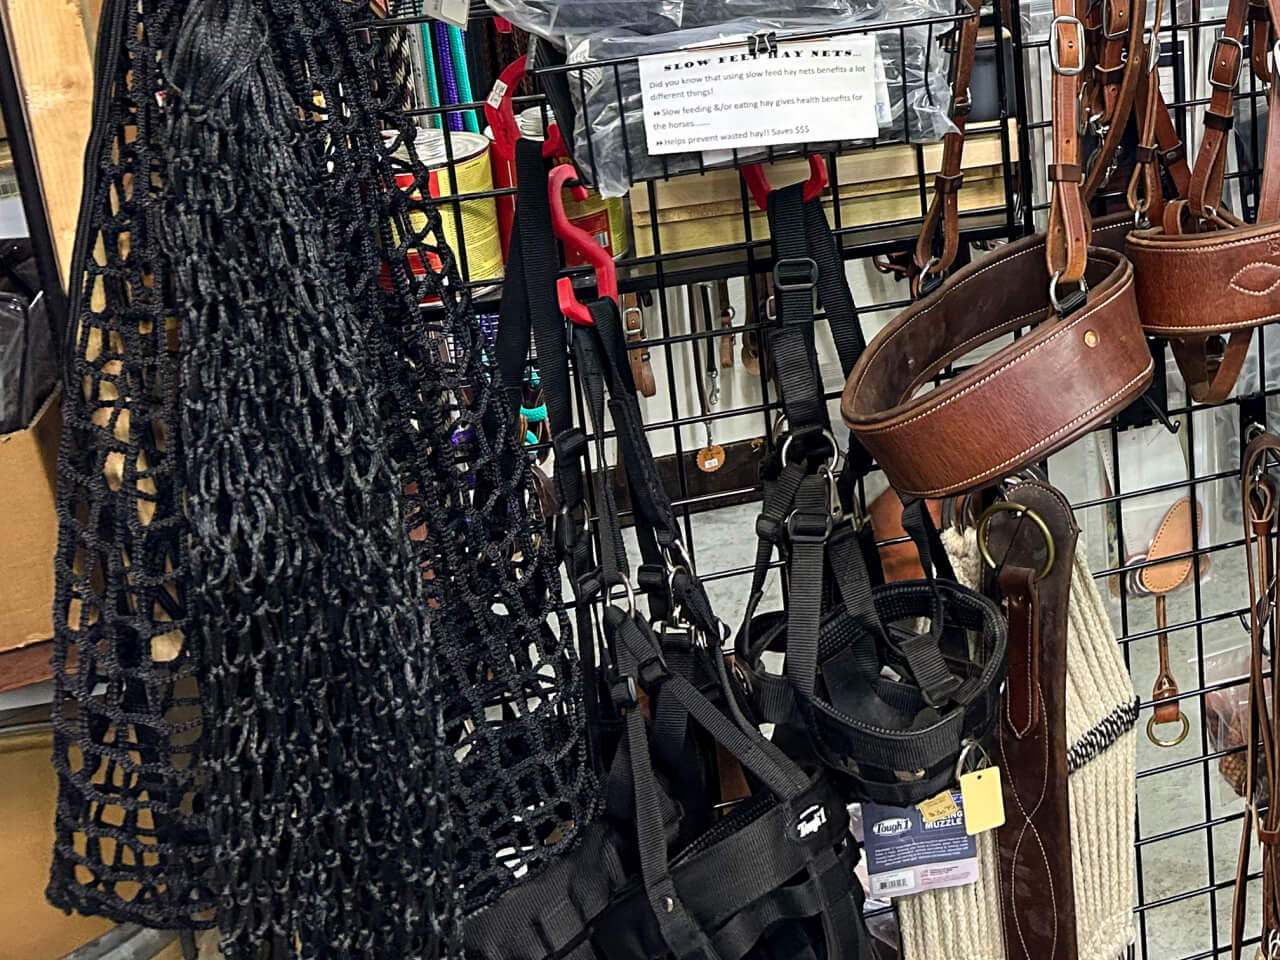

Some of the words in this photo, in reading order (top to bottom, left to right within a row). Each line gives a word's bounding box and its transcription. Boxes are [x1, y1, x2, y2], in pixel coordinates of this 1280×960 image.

[663, 57, 710, 72] SLOW
[649, 81, 663, 89] Did
[665, 80, 680, 89] you
[681, 77, 703, 85] know
[704, 74, 721, 82] that
[723, 72, 744, 81] using
[745, 70, 763, 79] slow
[765, 68, 783, 77] feed
[784, 68, 797, 77] hay
[798, 67, 815, 75] nets
[816, 65, 847, 74] benefits
[855, 64, 866, 73] lot
[650, 92, 684, 102] different
[686, 88, 714, 99] things!
[661, 109, 680, 117] Slow
[682, 105, 712, 116] feeding
[734, 100, 759, 110] eating
[760, 99, 773, 109] hay
[775, 97, 795, 108] gives
[796, 95, 820, 105] health
[821, 93, 851, 104] benefits
[852, 93, 863, 102] for
[664, 137, 686, 147] Helps
[688, 135, 718, 146] prevent
[720, 131, 748, 141] wasted
[771, 127, 793, 136] Saves
[795, 125, 810, 134] $$$
[924, 817, 963, 830] MUZZLE
